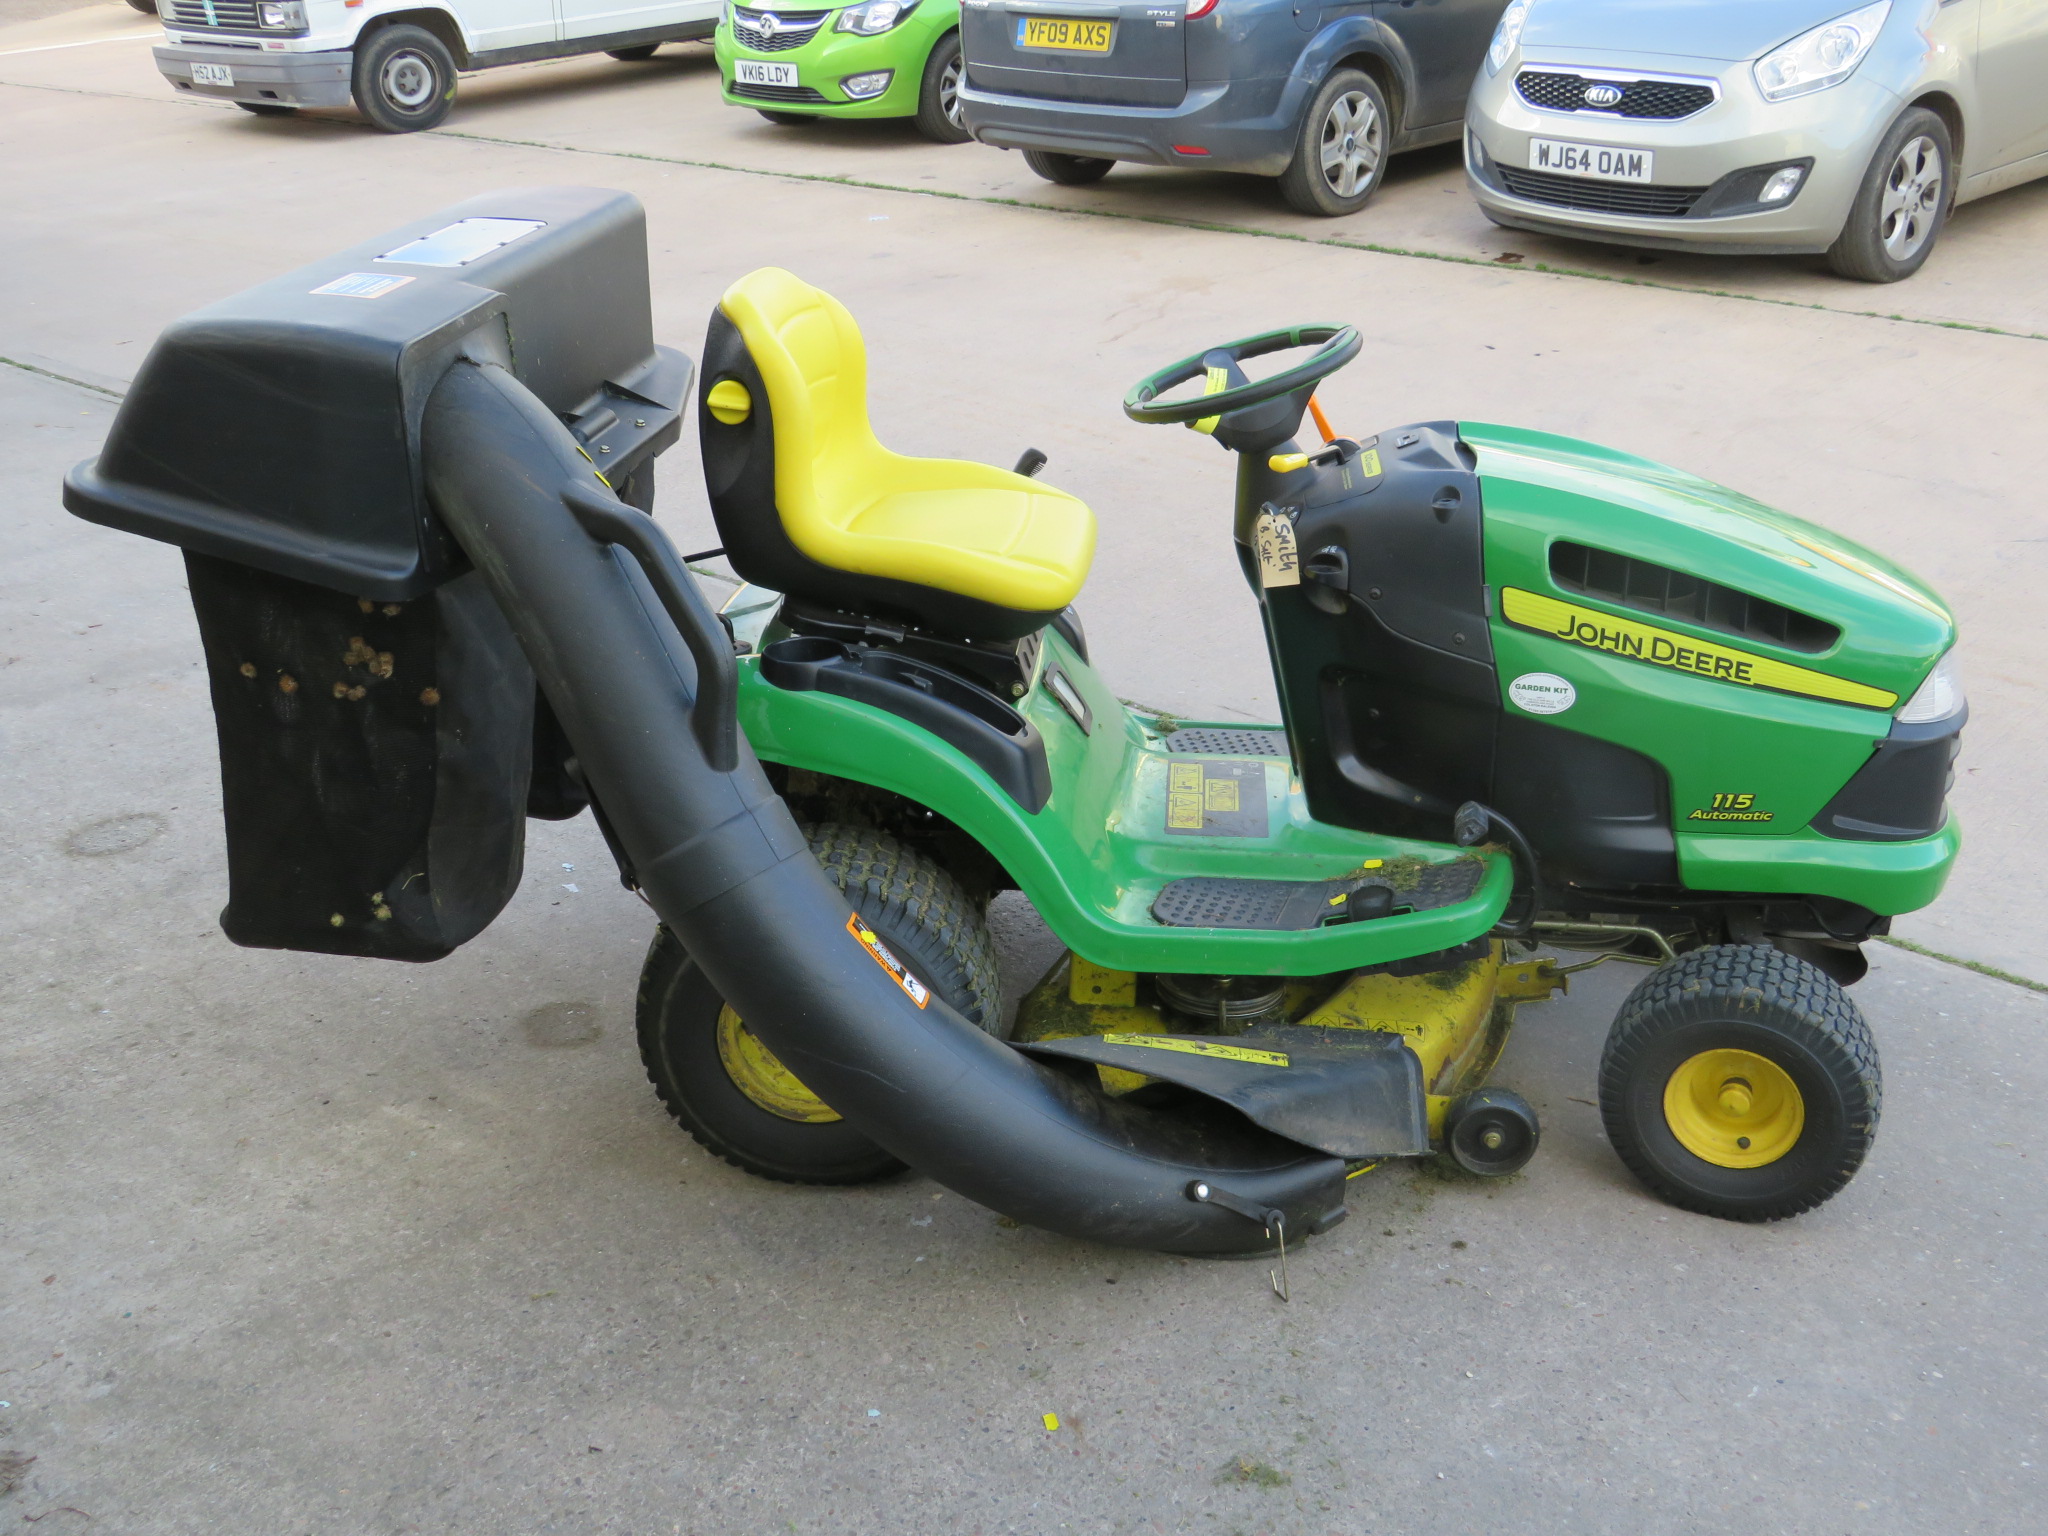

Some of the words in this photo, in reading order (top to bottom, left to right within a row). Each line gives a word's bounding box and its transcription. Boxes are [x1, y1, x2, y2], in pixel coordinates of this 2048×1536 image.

[1028, 21, 1069, 44] YF09
[1073, 25, 1108, 47] AXS
[211, 66, 229, 81] AJX
[741, 64, 765, 82] VK16
[767, 66, 789, 83] LDY
[1588, 88, 1614, 103] KIA
[1538, 143, 1592, 172] WJ64
[1598, 151, 1643, 177] OAM
[1557, 615, 1643, 656] JOHN
[1651, 636, 1754, 681] DEERE
[1514, 683, 1551, 693] GARDEN
[1711, 793, 1755, 810] 115
[1688, 809, 1774, 821] Automatic
